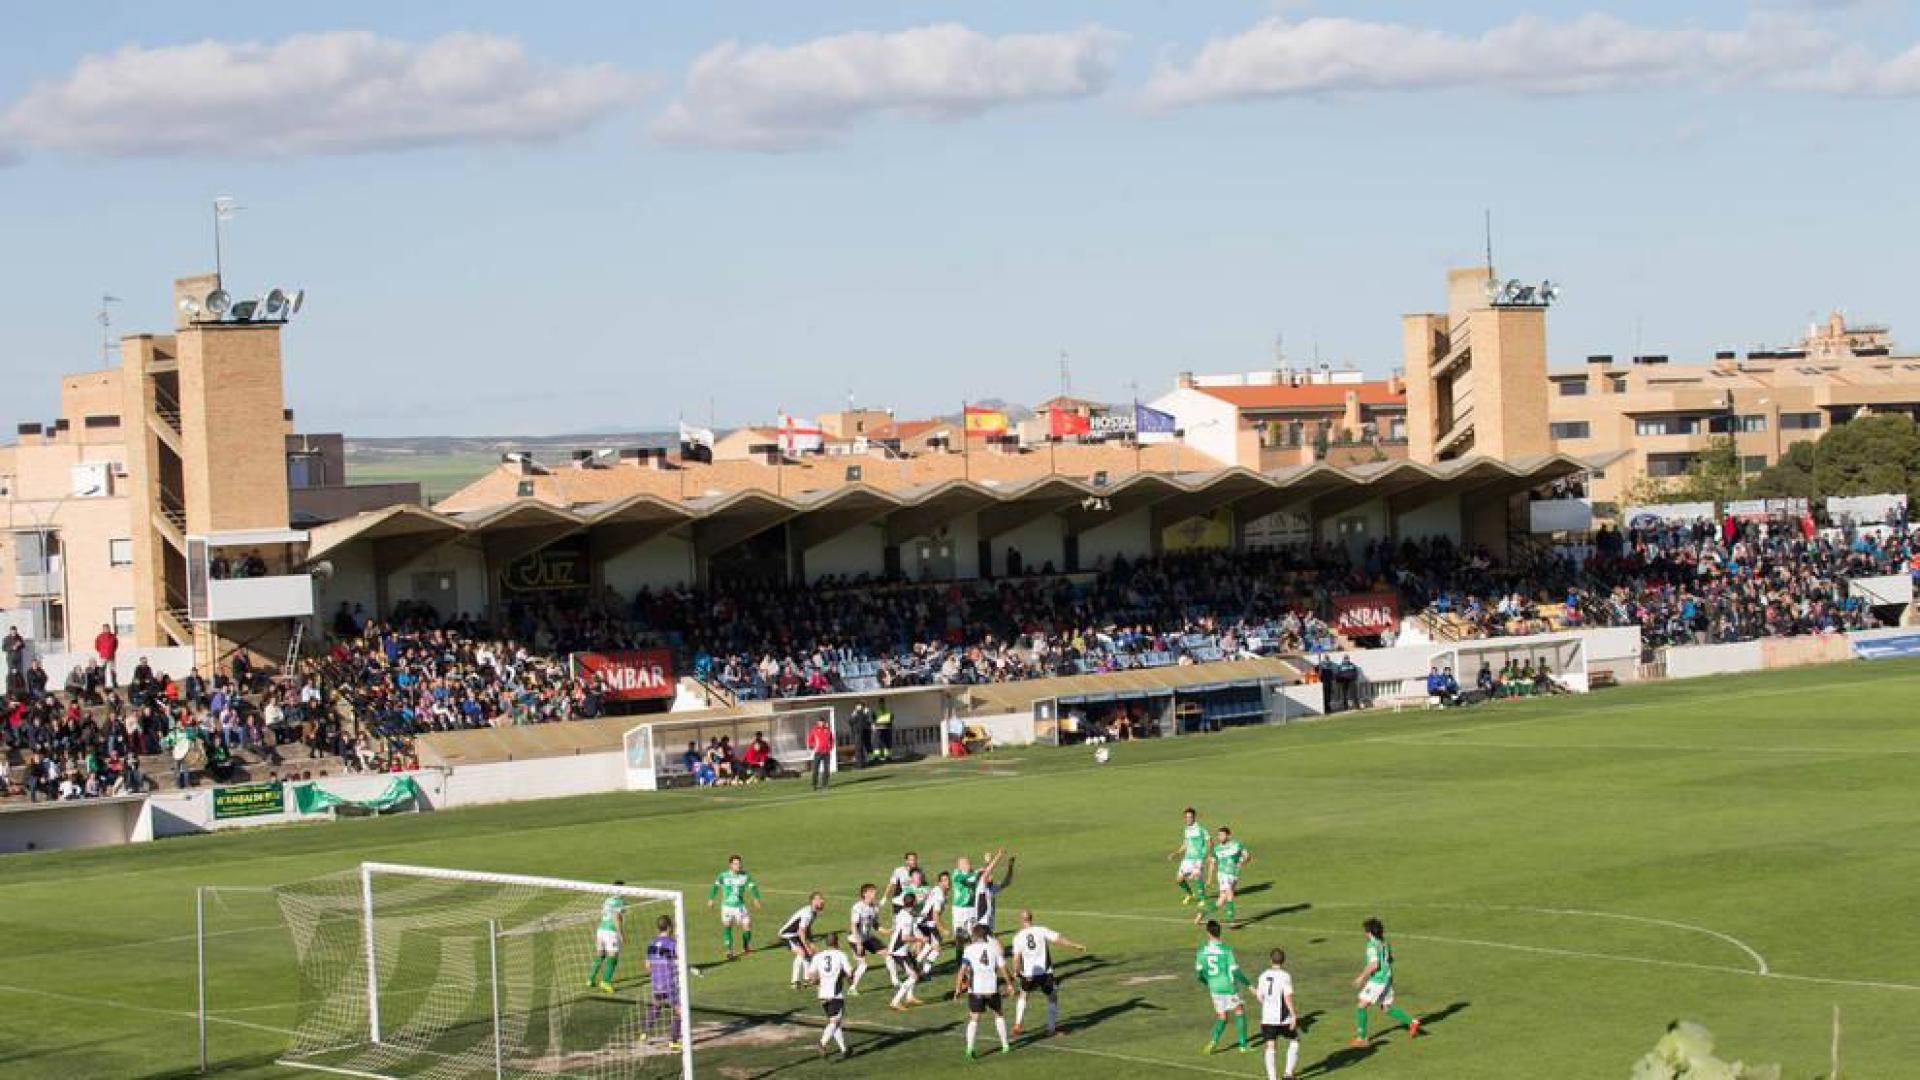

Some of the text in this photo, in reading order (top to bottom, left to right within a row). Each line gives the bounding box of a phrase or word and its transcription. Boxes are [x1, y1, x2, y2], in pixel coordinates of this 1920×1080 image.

[1339, 606, 1393, 627] AMBAR
[1026, 934, 1036, 949] 8
[823, 955, 832, 972] 3
[979, 950, 989, 966] 4
[1207, 955, 1219, 976] 5
[1266, 976, 1275, 995] 7
